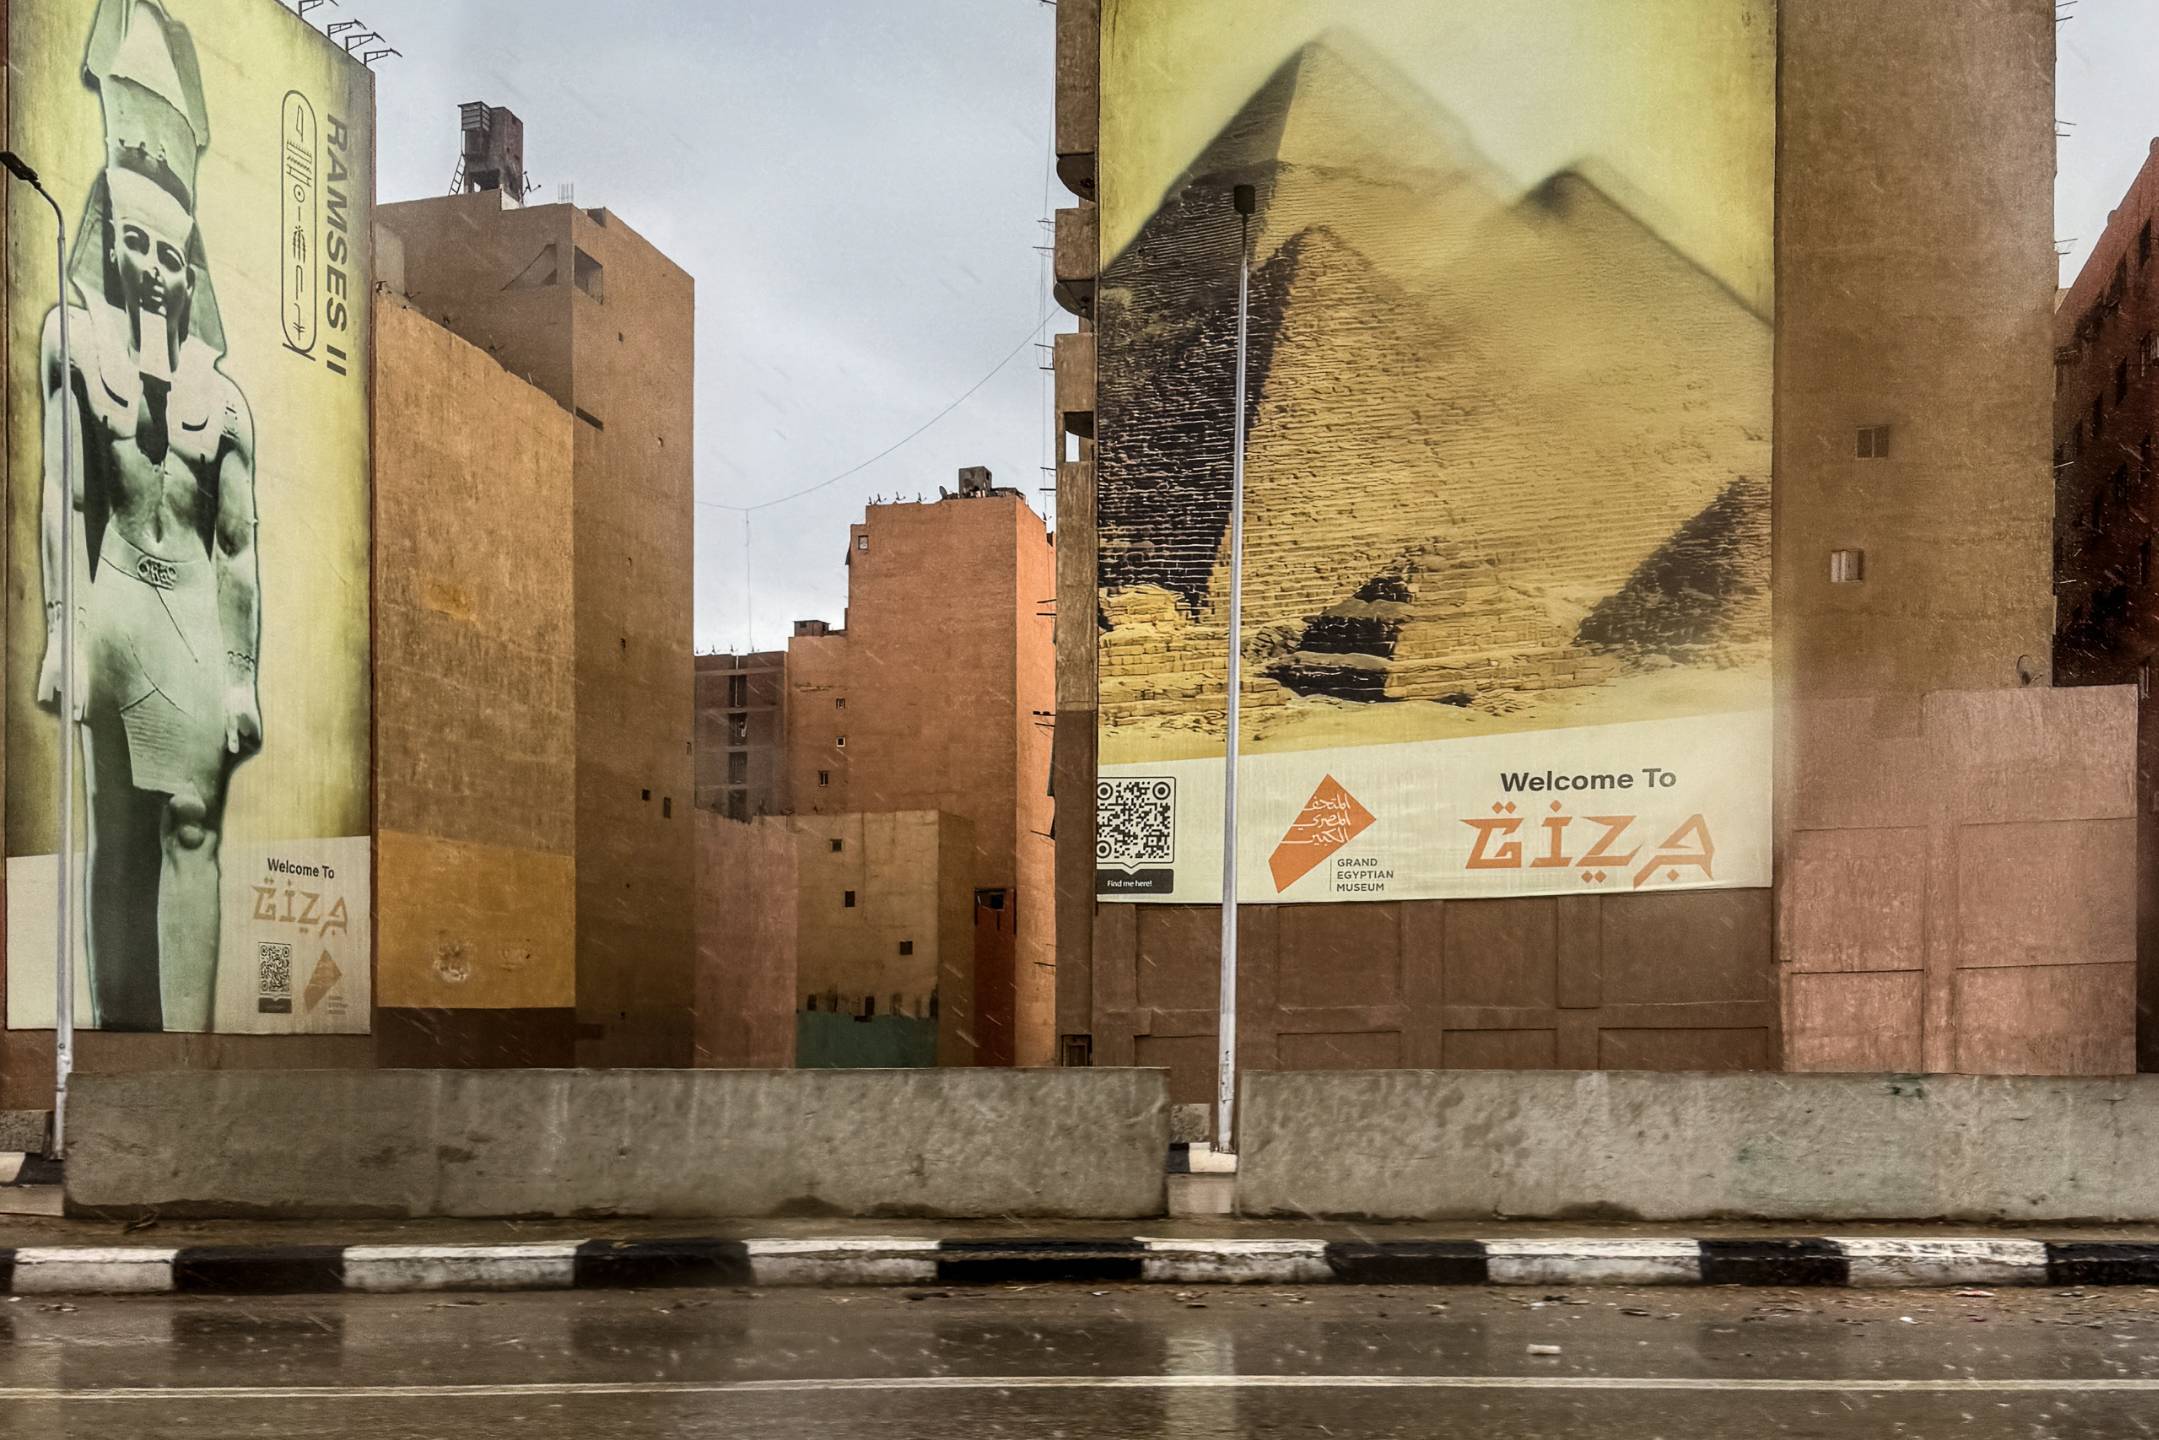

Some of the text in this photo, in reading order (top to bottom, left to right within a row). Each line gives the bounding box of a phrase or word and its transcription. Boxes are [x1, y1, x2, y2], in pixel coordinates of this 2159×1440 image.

[327, 113, 348, 376] RAMSES II
[1500, 768, 1677, 792] Welcome To
[1303, 793, 1351, 811] المتحف
[1280, 827, 1349, 847] الكبير
[267, 857, 335, 879] Welcome To
[1337, 858, 1378, 867] GRAND
[1337, 870, 1394, 880] EGYPTIAN
[1336, 883, 1385, 892] MUSEUM
